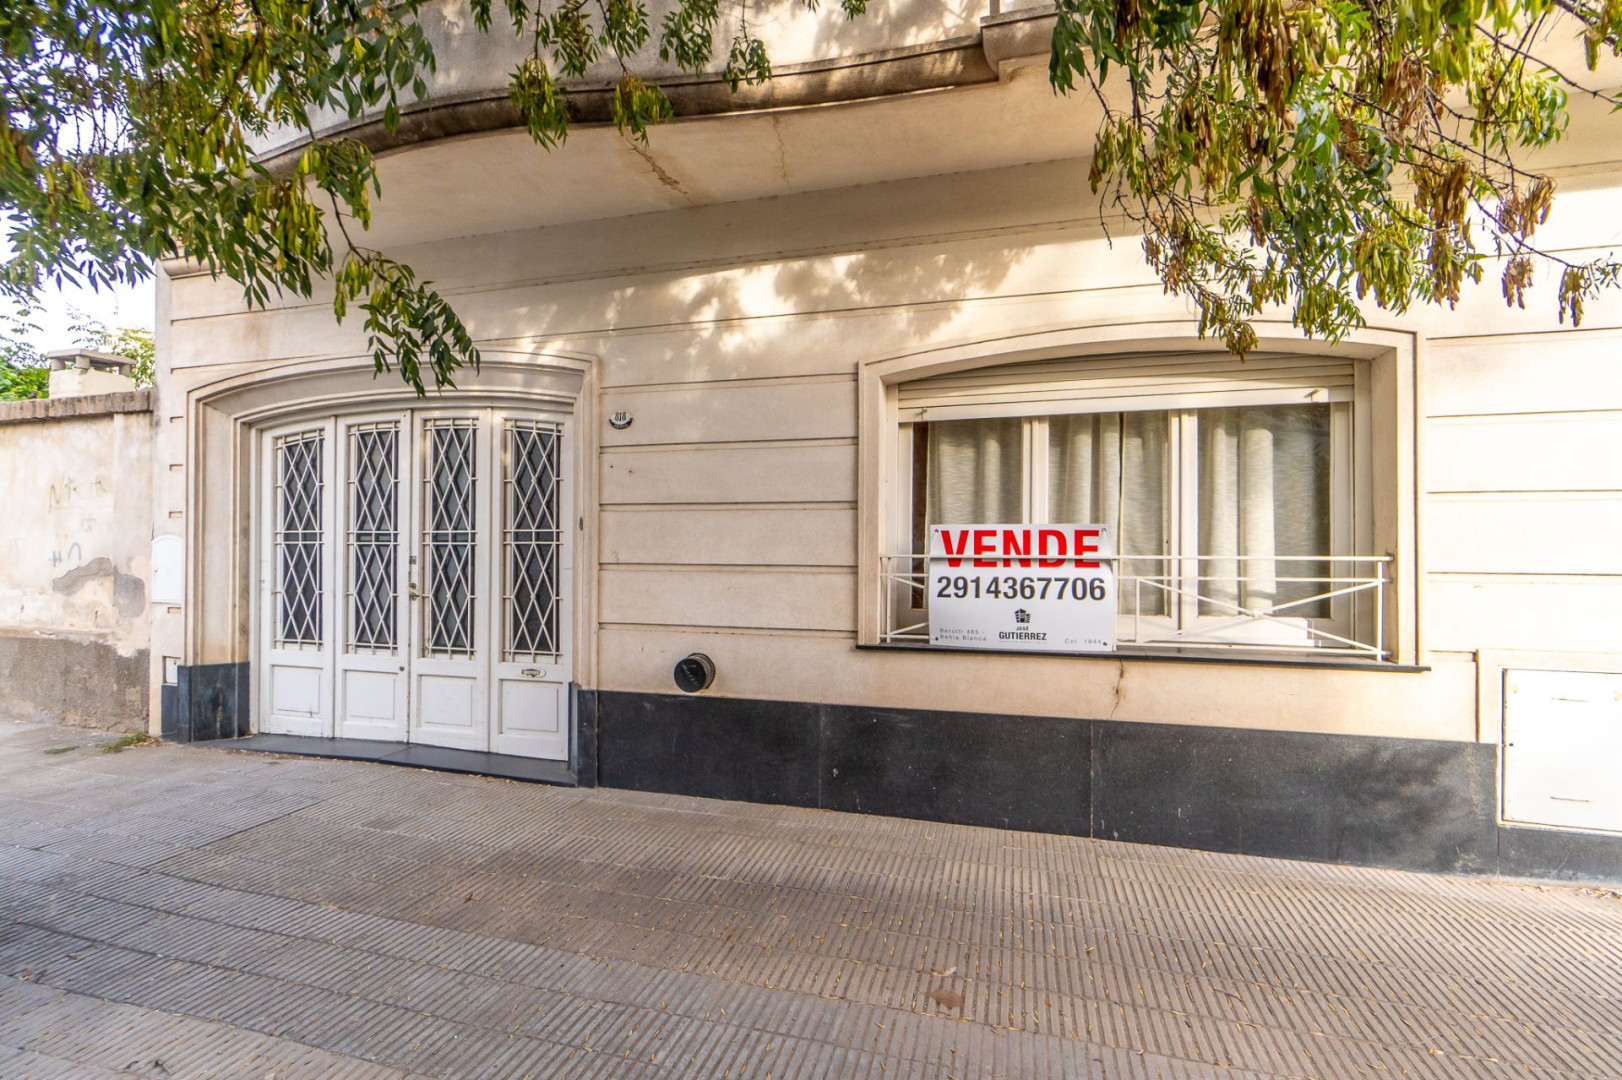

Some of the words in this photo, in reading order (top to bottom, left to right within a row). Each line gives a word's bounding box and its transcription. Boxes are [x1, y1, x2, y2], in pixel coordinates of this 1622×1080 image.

[615, 411, 627, 421] 818
[940, 530, 1101, 568] VENDE
[937, 576, 1106, 601] 2914367706
[998, 631, 1047, 641] GUTIERREZ
